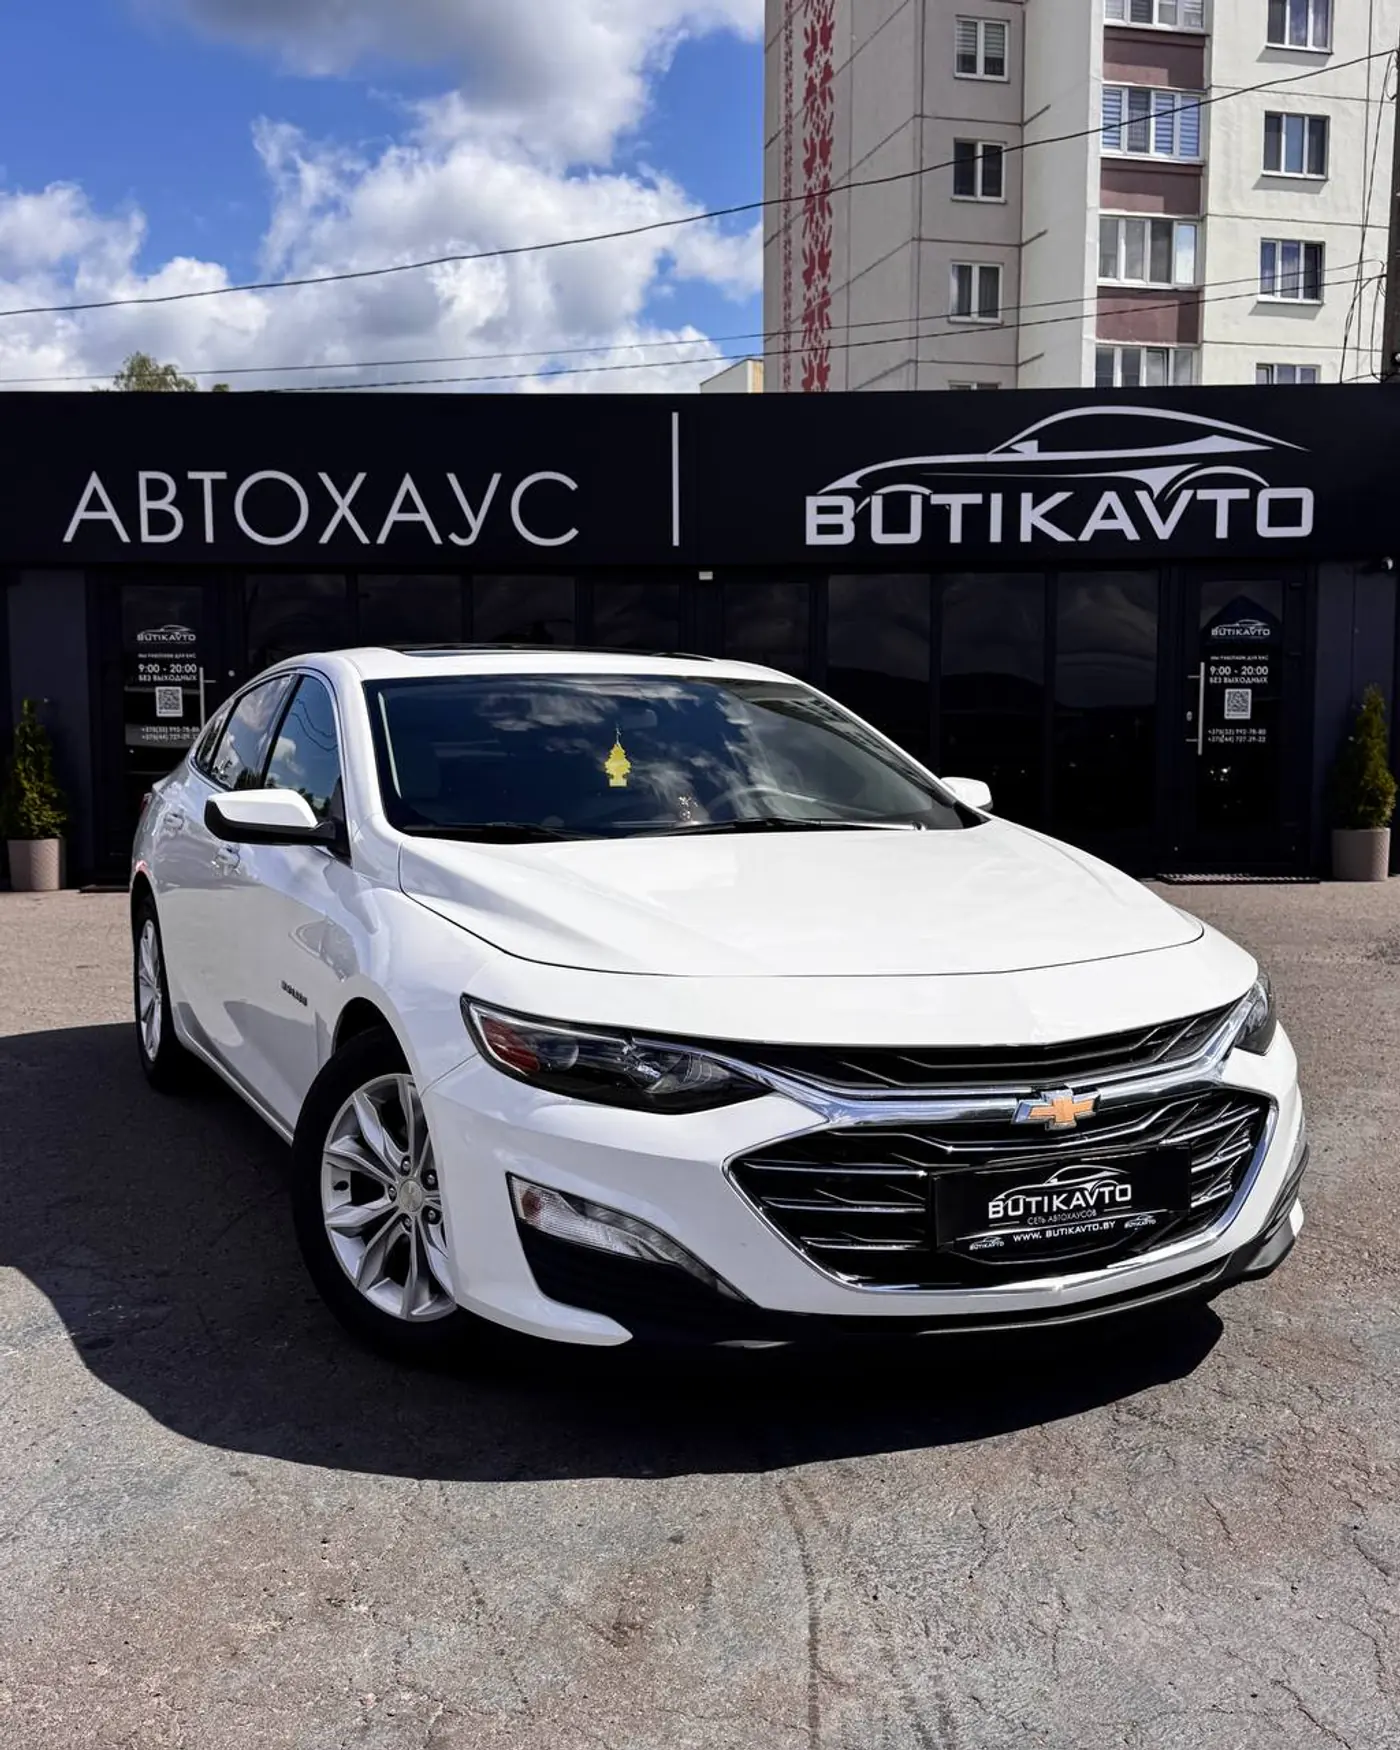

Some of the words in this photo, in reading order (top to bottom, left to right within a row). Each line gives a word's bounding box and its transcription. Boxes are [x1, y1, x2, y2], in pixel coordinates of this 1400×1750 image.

[63, 470, 579, 546] АВТОХАУС
[805, 487, 1314, 545] BUTIKAVTO
[1211, 628, 1270, 636] BUTIKAVTO
[138, 663, 160, 673] 9:00
[169, 663, 197, 673] 20:00
[1209, 665, 1231, 676] 9:00
[1241, 665, 1269, 675] 20:00
[138, 674, 151, 682] БЕЗ
[152, 674, 198, 682] ВЫХОДНЫХ
[1209, 676, 1222, 684] БЕЗ
[1223, 676, 1269, 684] ВЫХОДНЫХ
[988, 1184, 1132, 1219] BUTIKAVTO
[1027, 1216, 1047, 1226] СЕТЬ
[1047, 1210, 1097, 1223] АВТОХАУСОВ
[1012, 1231, 1042, 1242] WWW.
[1045, 1221, 1116, 1238] BUTIKAVTO.BY
